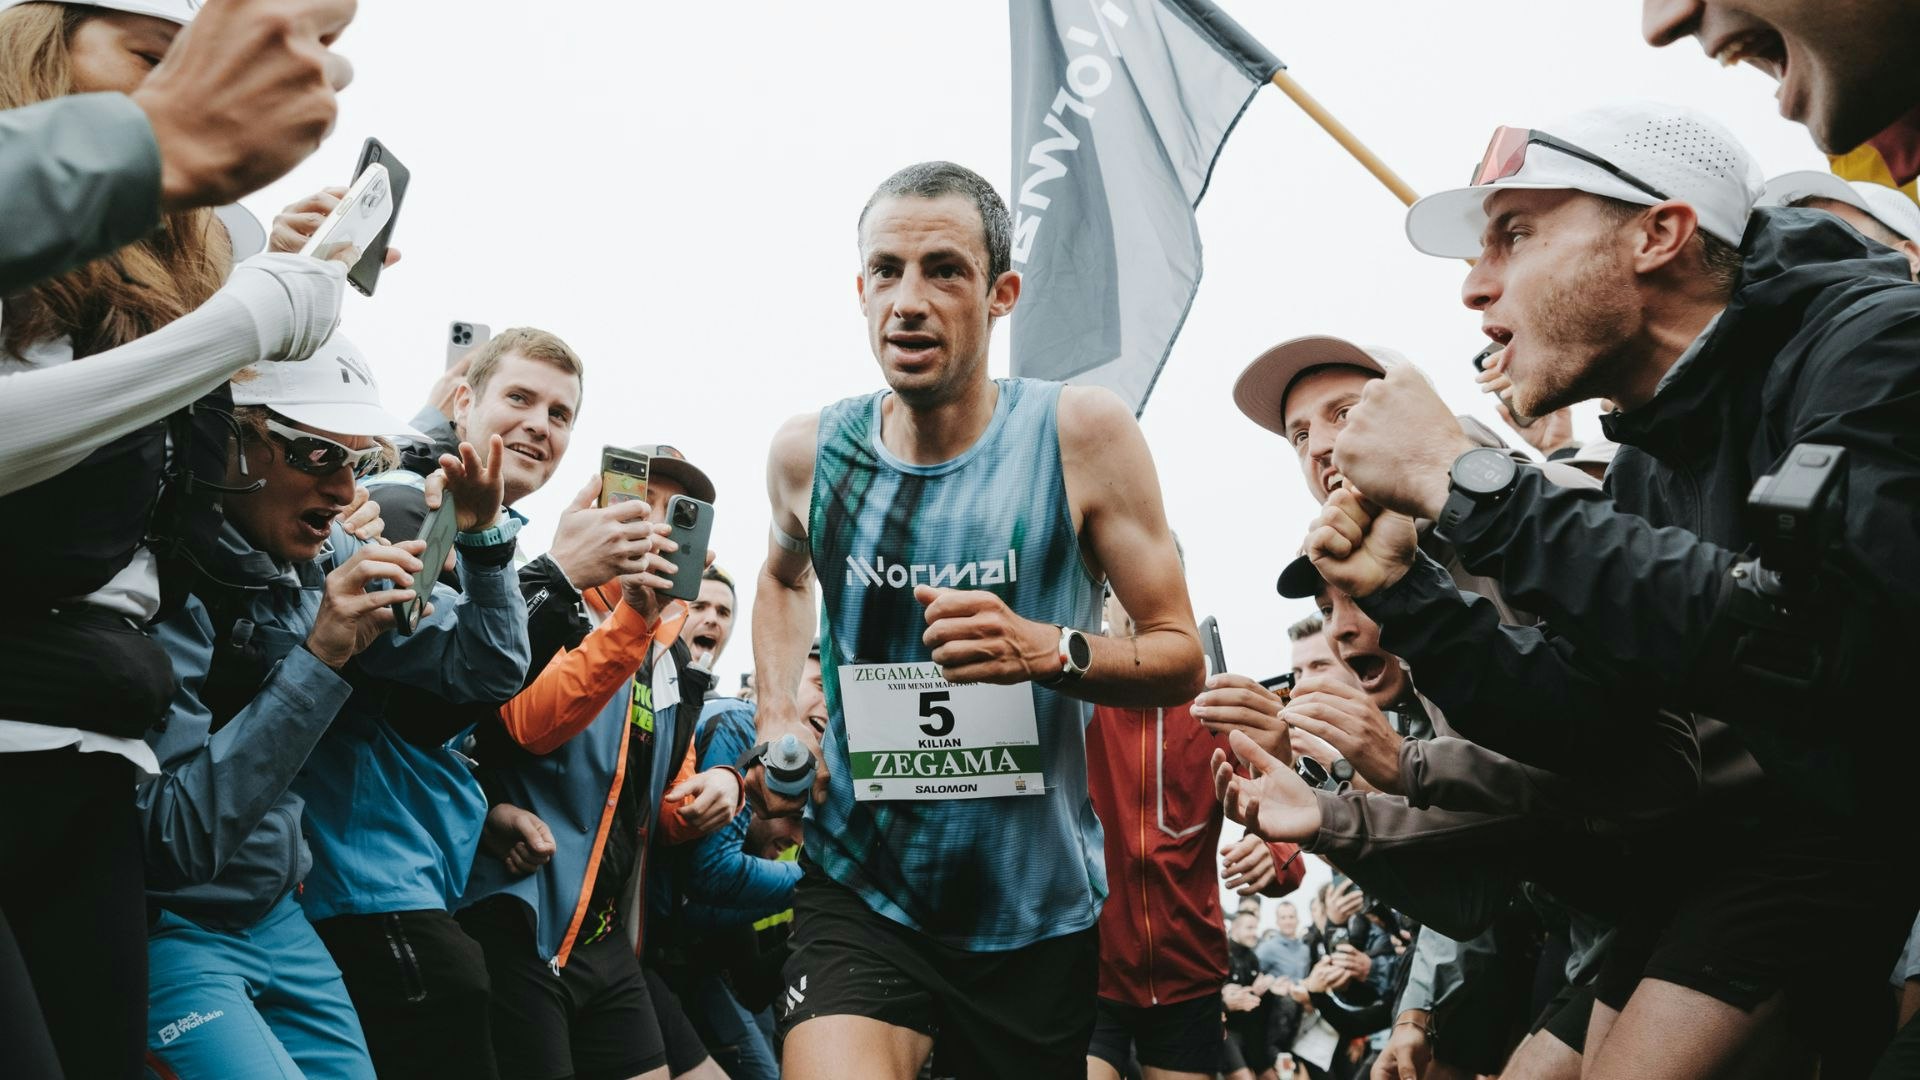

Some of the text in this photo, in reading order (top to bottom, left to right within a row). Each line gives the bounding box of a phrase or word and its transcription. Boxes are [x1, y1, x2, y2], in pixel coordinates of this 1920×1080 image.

[854, 665, 942, 681] ZEGAMA-A
[907, 682, 933, 690] MENDI
[919, 691, 955, 737] 5
[918, 738, 961, 749] KILIAN
[871, 748, 1020, 776] ZEGAMA
[915, 783, 978, 794] SALOMON
[177, 1012, 200, 1027] Jack
[177, 1010, 224, 1033] Wolfskin
